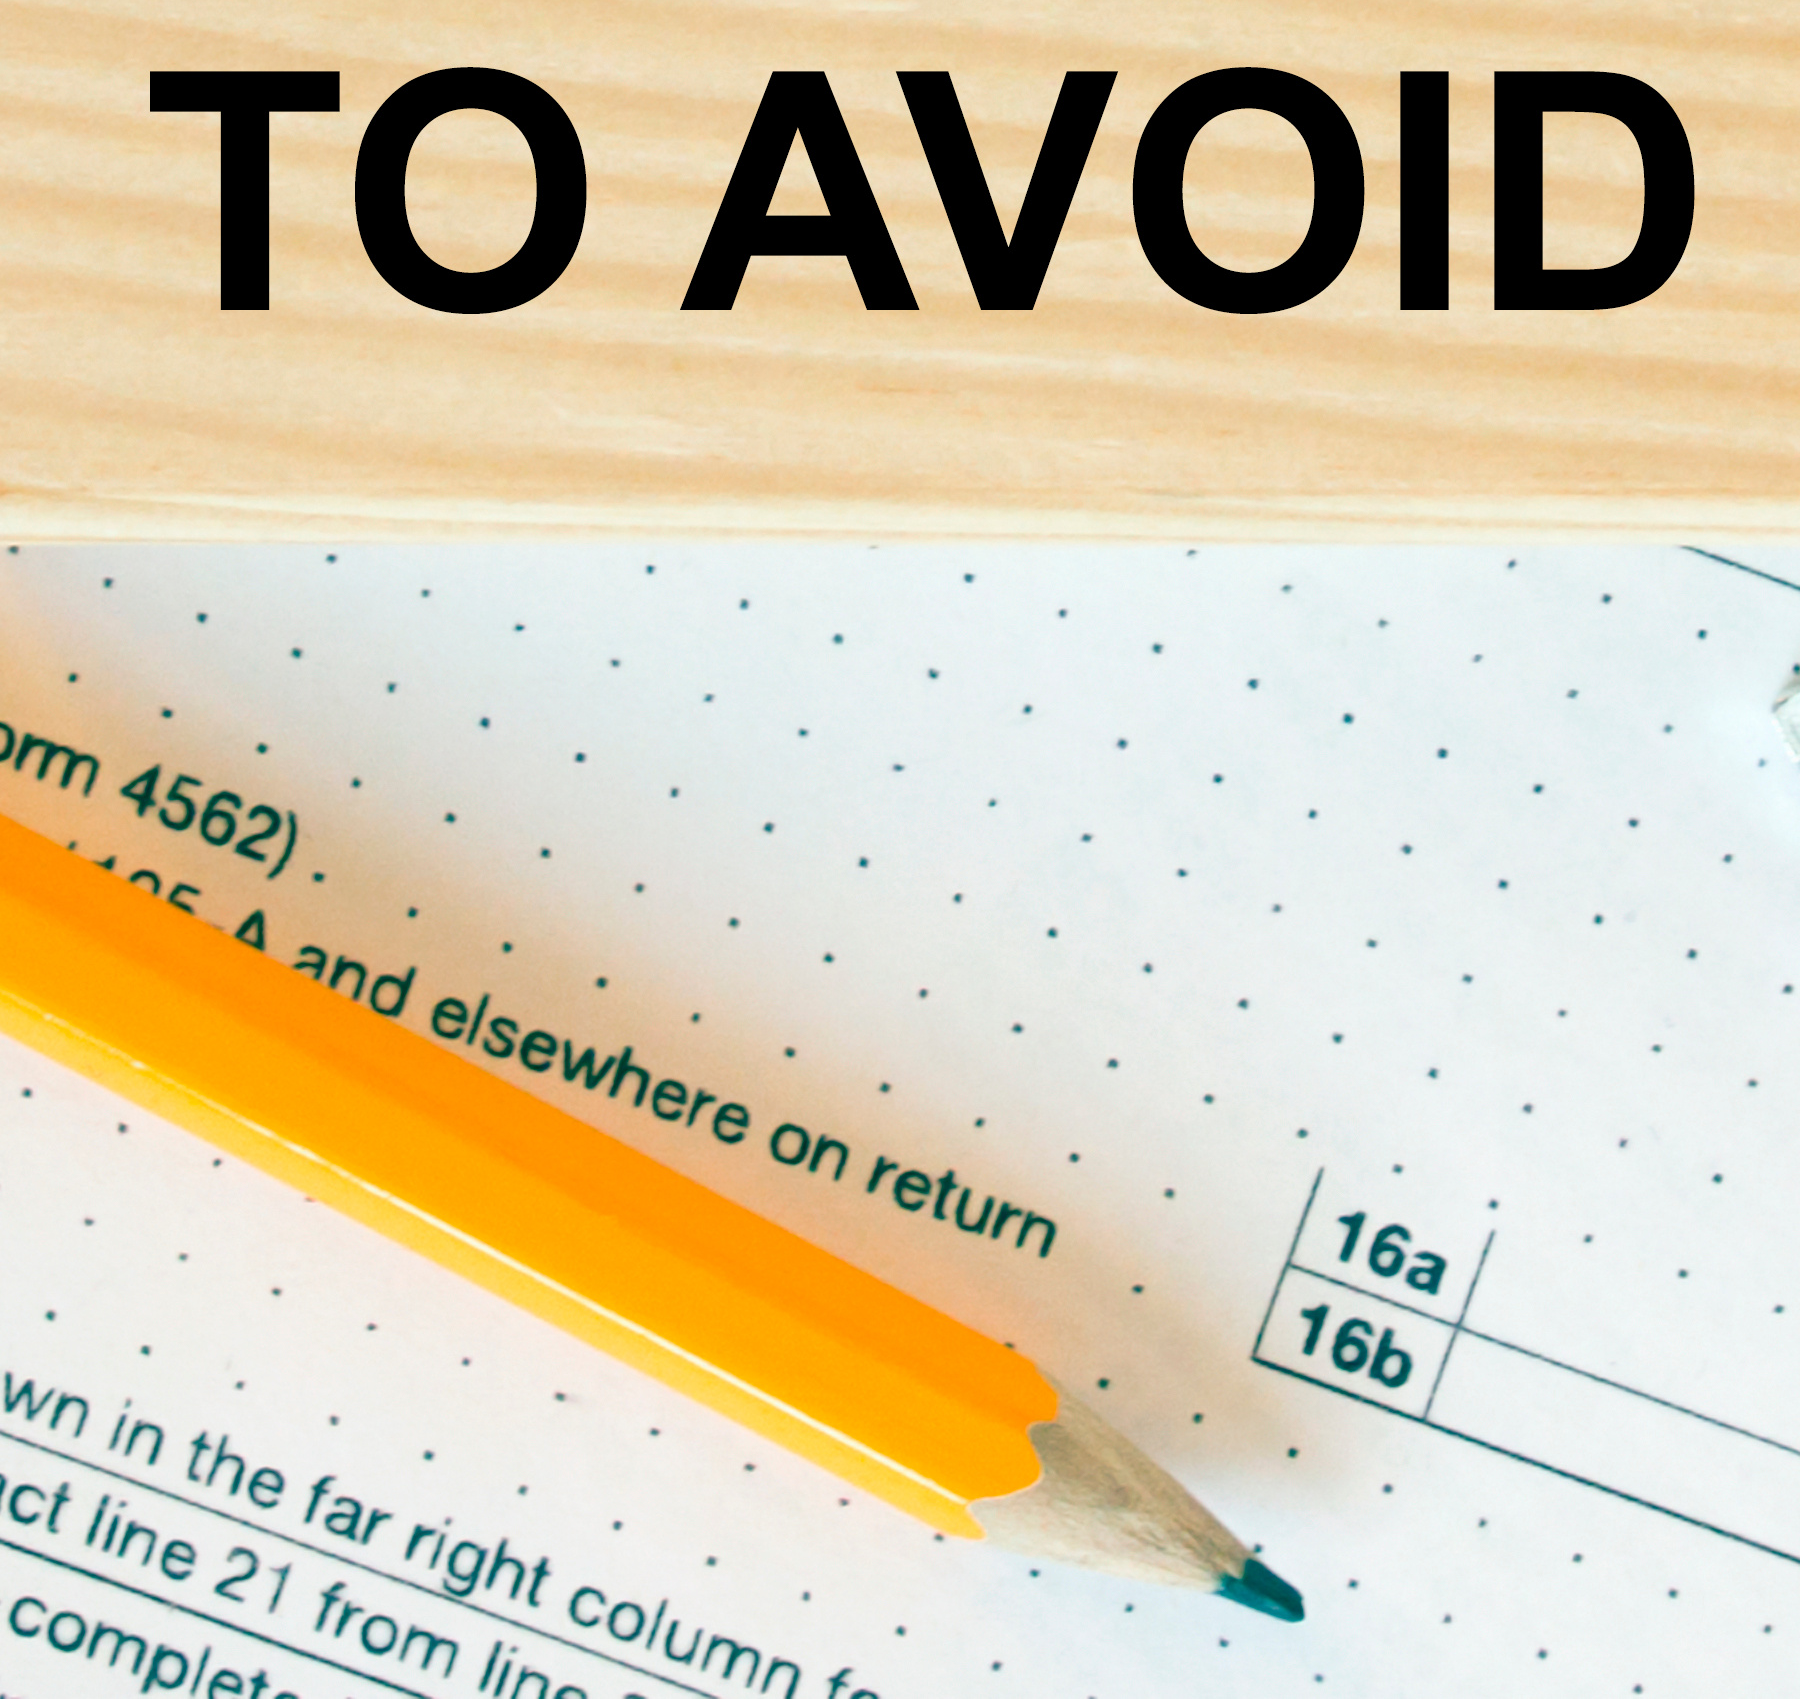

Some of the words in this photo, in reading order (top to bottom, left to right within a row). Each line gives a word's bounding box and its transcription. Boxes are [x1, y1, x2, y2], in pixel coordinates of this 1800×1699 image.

[148, 65, 589, 316] TO
[678, 65, 1697, 316] AVOID
[118, 762, 300, 882] 4562)
[429, 991, 752, 1147] elsewhere
[767, 1121, 852, 1183] on
[864, 1154, 1059, 1260] return
[1336, 1209, 1449, 1298] 16a
[1299, 1302, 1415, 1390] 16b
[107, 1412, 166, 1468] in
[186, 1430, 287, 1511] the
[302, 1474, 394, 1547] far
